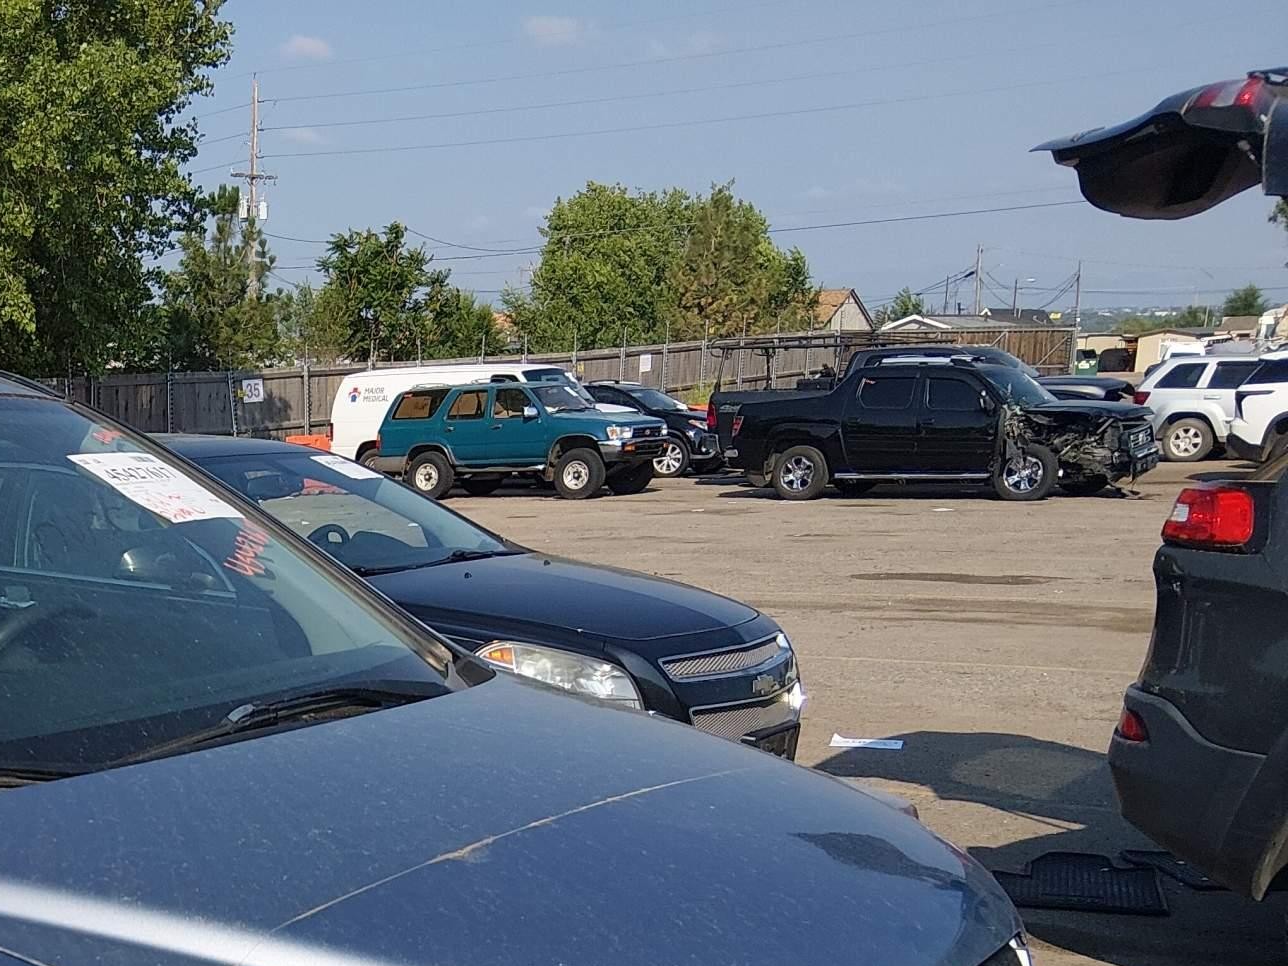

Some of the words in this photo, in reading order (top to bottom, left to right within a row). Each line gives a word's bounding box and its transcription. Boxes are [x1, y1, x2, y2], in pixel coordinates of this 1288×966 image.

[246, 382, 260, 399] 35
[364, 387, 385, 395] MAJOR
[362, 395, 389, 403] MEDICAL
[104, 466, 177, 482] 45427617
